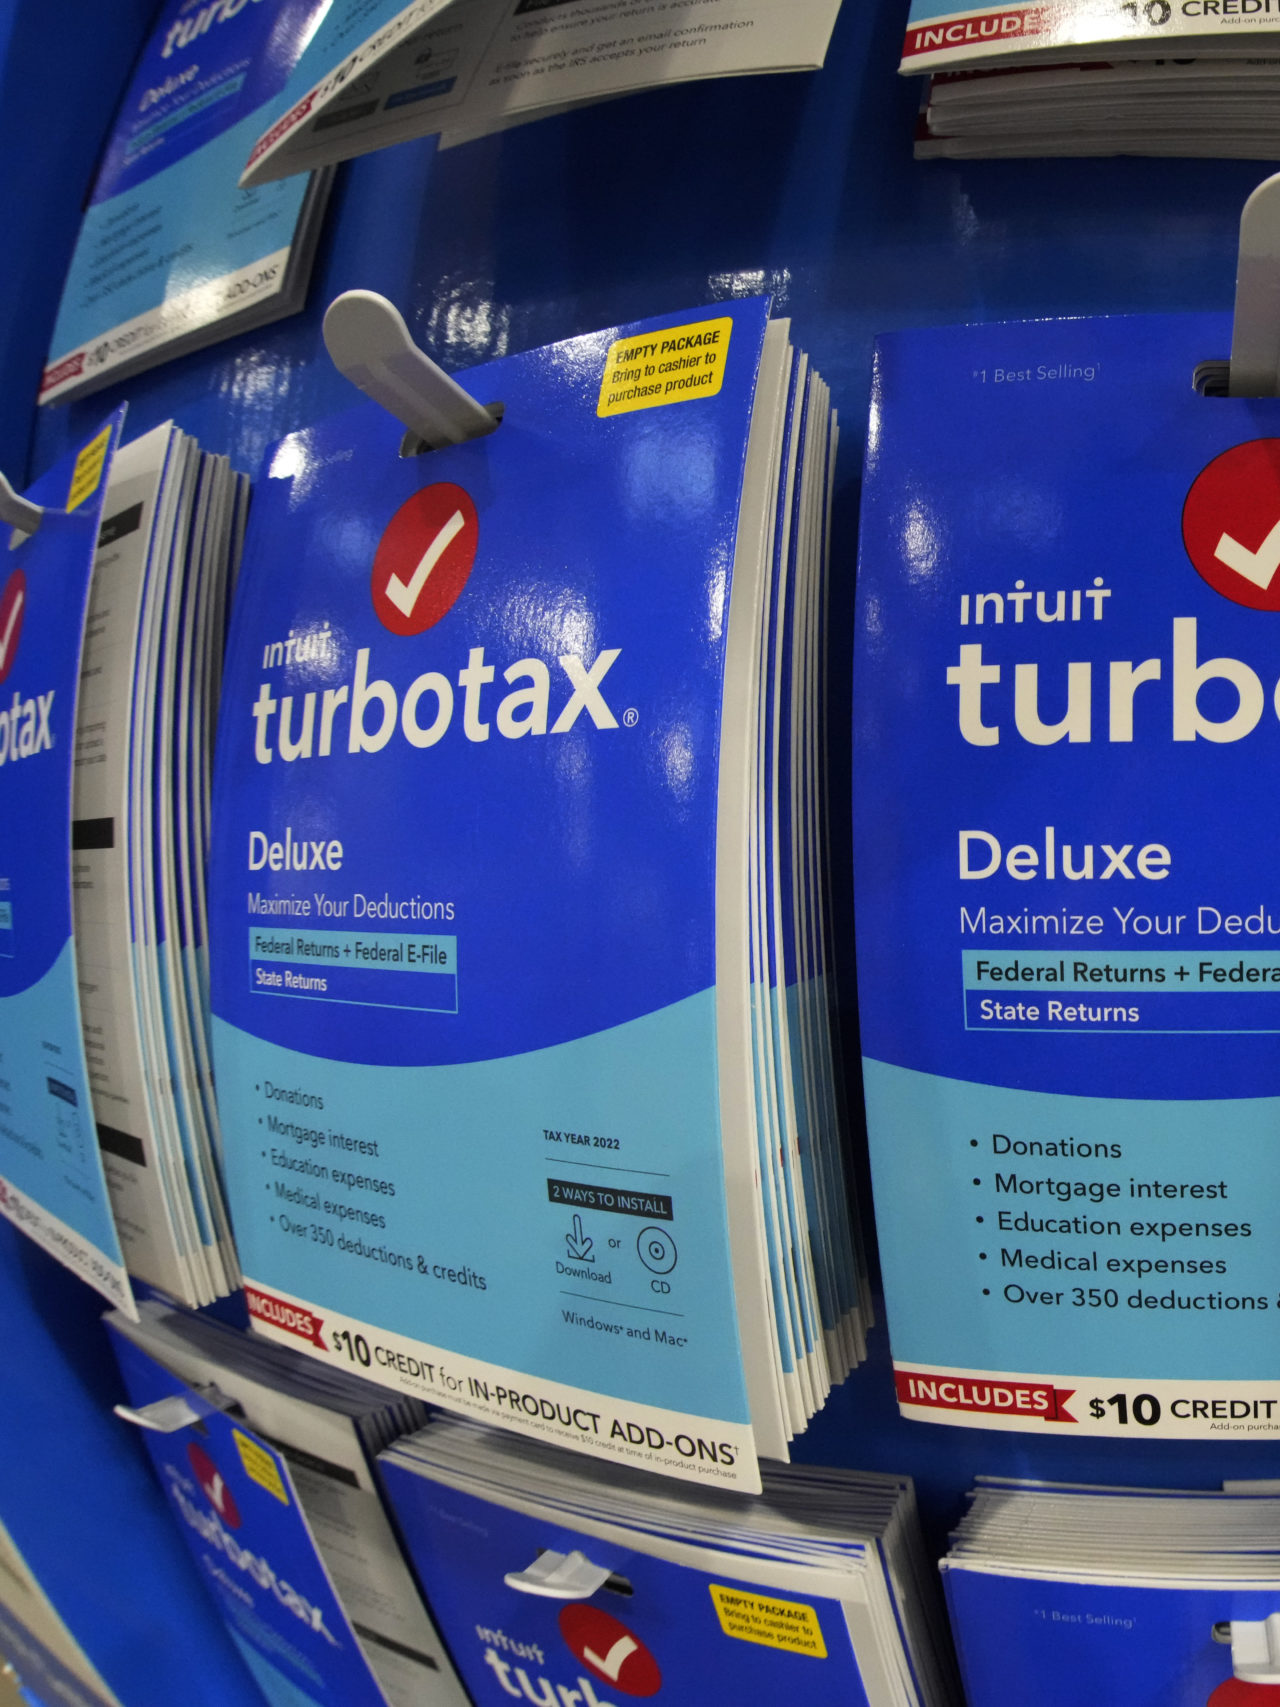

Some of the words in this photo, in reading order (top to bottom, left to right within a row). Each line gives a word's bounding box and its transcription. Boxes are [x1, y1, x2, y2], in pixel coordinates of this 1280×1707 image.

[615, 342, 657, 364] EMPTY
[660, 330, 720, 357] PACKAGE
[612, 364, 641, 385] Bring
[645, 364, 654, 377] to
[658, 355, 703, 376] cashier
[706, 350, 717, 364] to
[994, 368, 1032, 382] Best
[607, 382, 661, 405] purchase
[665, 370, 713, 394] product
[248, 827, 344, 871] Deluxe
[958, 826, 1172, 880] Deluxe
[248, 892, 311, 917] Maximize
[313, 893, 350, 918] Your
[353, 892, 455, 921] Deductions
[960, 906, 1104, 935] Maximize
[1113, 906, 1187, 935] Your
[255, 935, 294, 955] Federal
[297, 938, 340, 958] Returns
[355, 941, 403, 963] Federal
[407, 944, 447, 964] E-File
[255, 967, 283, 987] State
[284, 970, 328, 992] Returns
[976, 961, 1065, 982] Federal
[1073, 962, 1166, 983] Returns
[1174, 965, 1190, 981] +
[980, 999, 1040, 1021] State
[1048, 1000, 1140, 1023] Returns
[264, 1081, 324, 1110] Donations
[267, 1115, 326, 1148] Mortgage
[328, 1129, 380, 1158] interest
[543, 1129, 562, 1142] TAX
[565, 1132, 591, 1146] YEAR
[593, 1136, 620, 1150] 2022
[992, 1134, 1122, 1158] Donations
[271, 1149, 329, 1180] Education
[332, 1168, 396, 1197] expenses
[994, 1173, 1121, 1202] Mortgage
[1130, 1177, 1228, 1199] interest
[275, 1181, 321, 1210] Medical
[323, 1199, 386, 1229] expenses
[998, 1211, 1121, 1236] Education
[1130, 1220, 1252, 1241] expenses
[279, 1214, 308, 1239] Over
[311, 1224, 335, 1247] 350
[337, 1233, 413, 1270] deductions
[417, 1255, 429, 1275] &
[433, 1263, 488, 1291] credits
[1000, 1248, 1098, 1271] Medical
[1106, 1257, 1227, 1278] expenses
[1003, 1284, 1064, 1306] Over
[1071, 1288, 1119, 1308] 350
[1127, 1289, 1269, 1310] deductions
[247, 1291, 314, 1335] INCLUDES
[332, 1330, 372, 1367] $10
[375, 1346, 434, 1384] CREDIT
[439, 1367, 464, 1393] for
[467, 1377, 601, 1434] IN-PRODUCT
[907, 1378, 1049, 1411] INCLUDES
[1089, 1393, 1162, 1426] $10
[1170, 1399, 1278, 1419] CREDIT
[1209, 1422, 1245, 1431] Add-on
